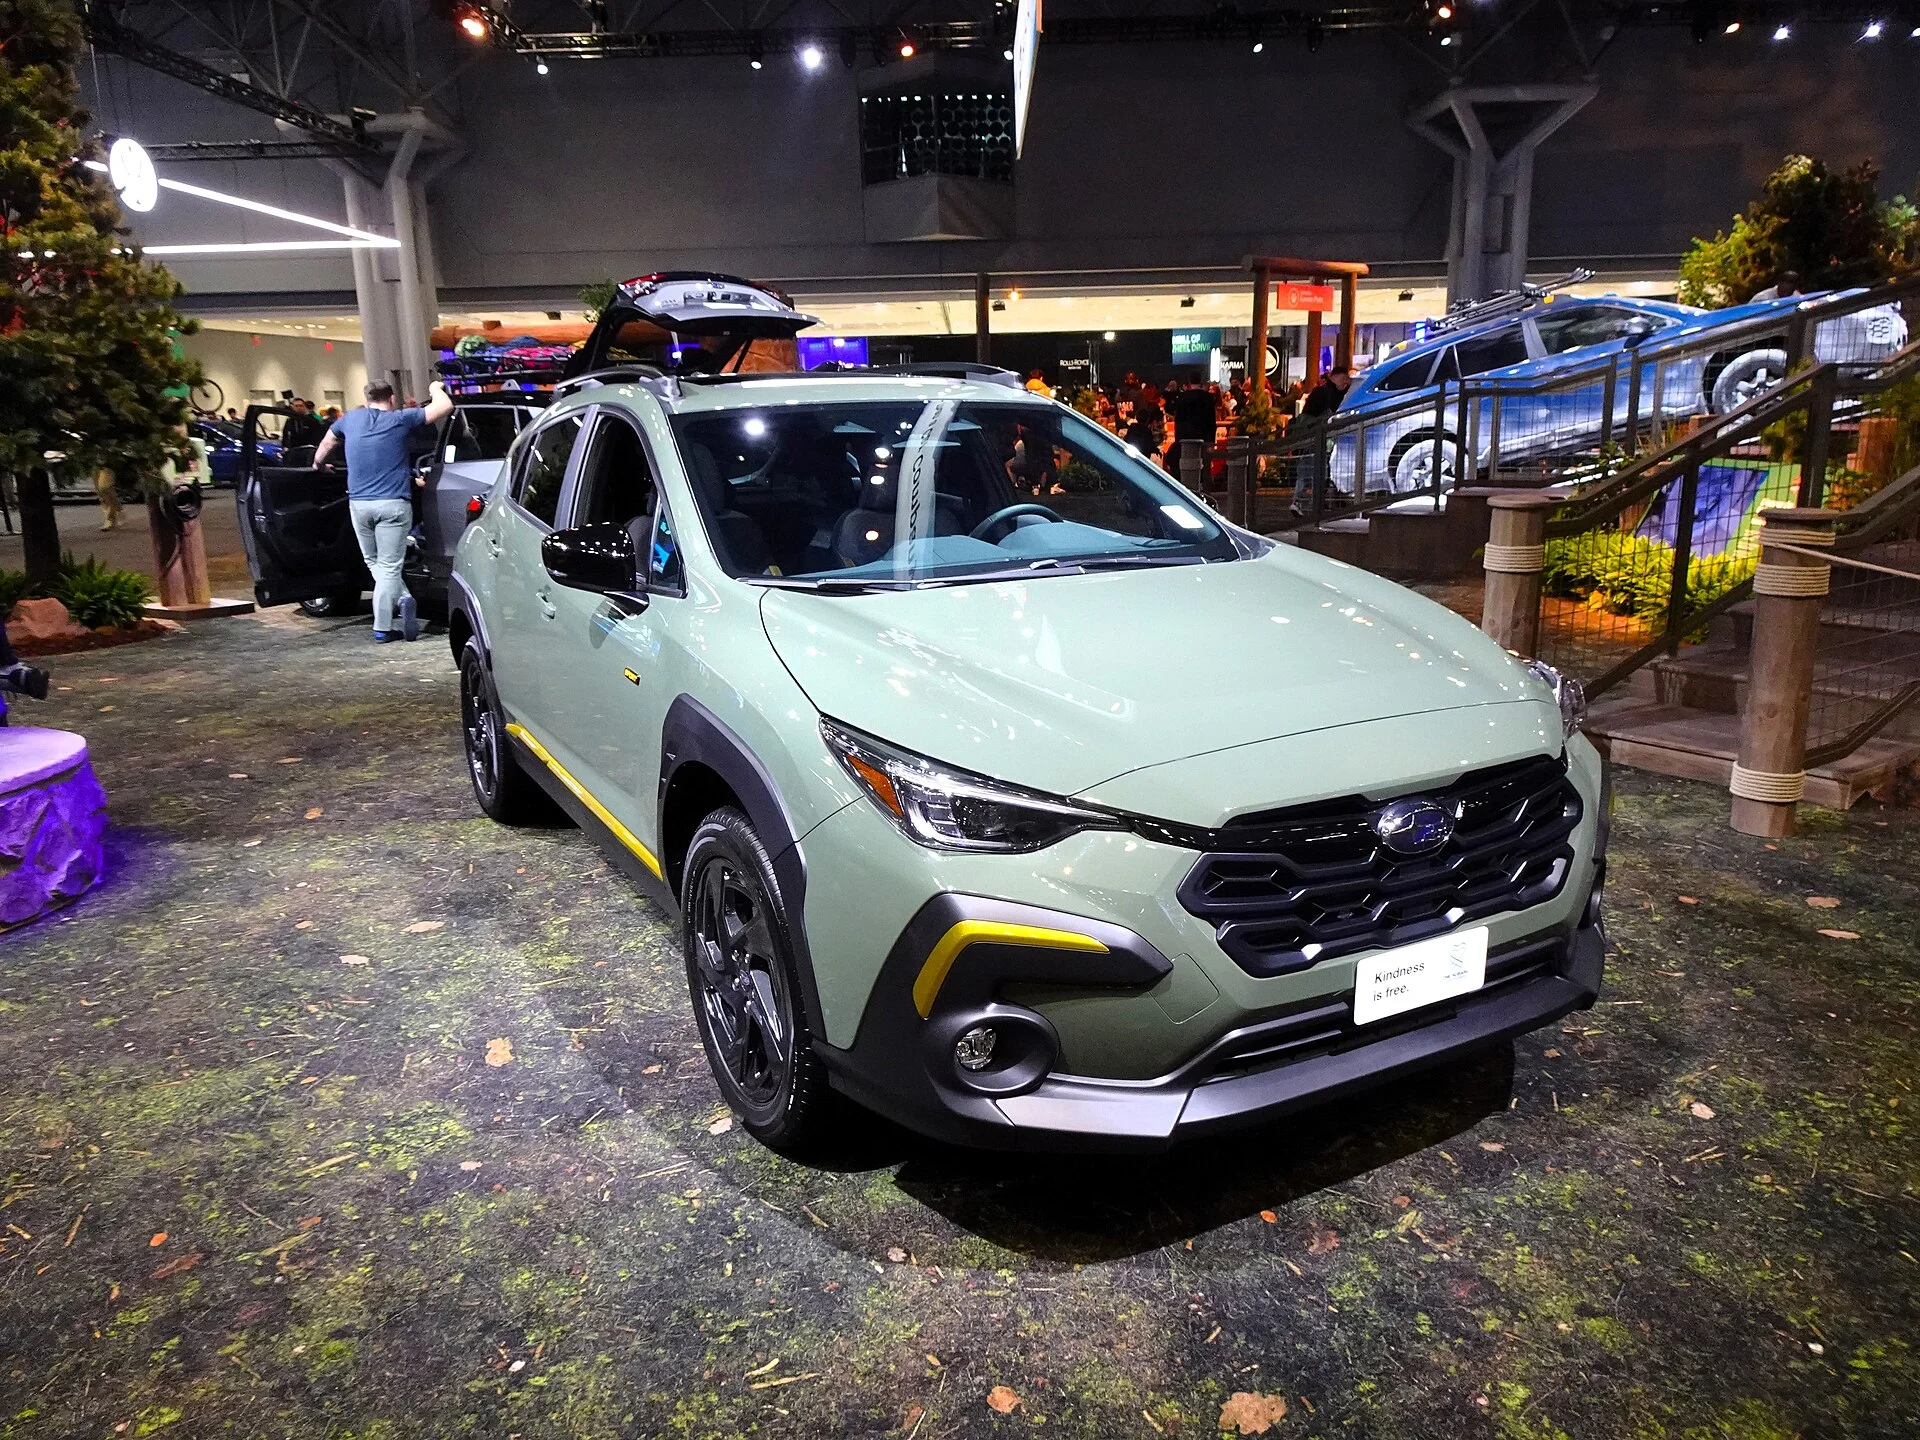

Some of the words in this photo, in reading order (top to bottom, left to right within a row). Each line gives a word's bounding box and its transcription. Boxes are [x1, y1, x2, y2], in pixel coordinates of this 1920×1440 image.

[1374, 962, 1425, 984] Kindness
[1373, 990, 1382, 1001] is
[1385, 984, 1410, 998] free.
